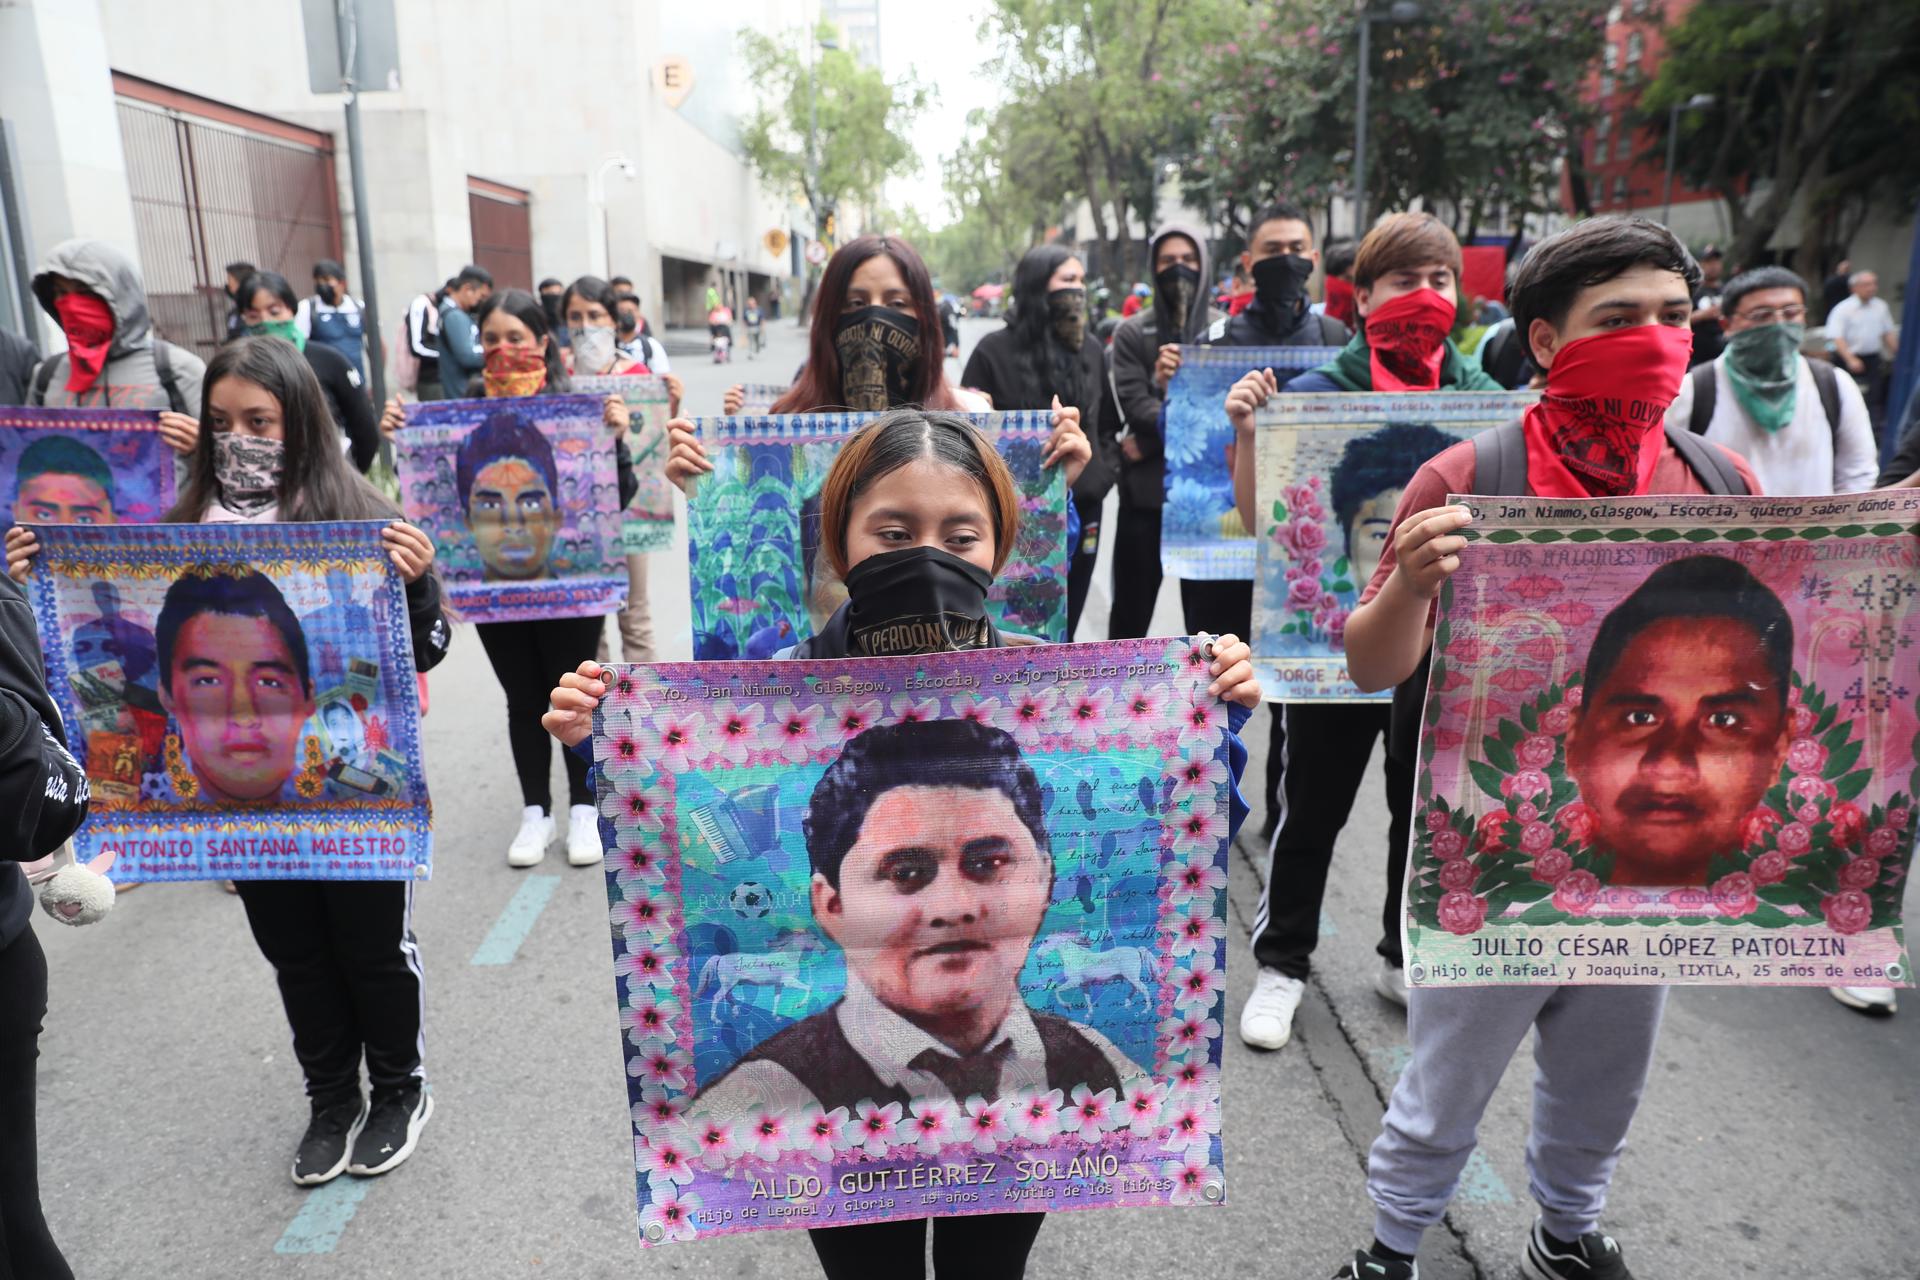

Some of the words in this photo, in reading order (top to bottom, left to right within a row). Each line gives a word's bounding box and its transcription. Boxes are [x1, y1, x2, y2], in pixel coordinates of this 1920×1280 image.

[665, 65, 680, 87] E
[1604, 399, 1622, 417] NI
[717, 420, 736, 431] Jan
[1472, 508, 1487, 521] o,
[1498, 506, 1526, 519] Jan
[1670, 504, 1739, 519] Escocia,
[1750, 505, 1803, 519] quiero
[1812, 503, 1850, 516] saber
[1857, 499, 1896, 513] dónde
[179, 529, 230, 541] Escocia,
[871, 618, 942, 655] PERDÓN
[659, 688, 688, 702] Yo,
[702, 685, 731, 699] Jan
[742, 683, 801, 698] Nimmo,
[814, 680, 892, 695] Glasgow,
[905, 673, 981, 691] Escocia,
[993, 669, 1041, 686] exijo
[1127, 663, 1165, 681] para
[1274, 668, 1325, 683] JORGE
[1319, 686, 1331, 695] de
[100, 840, 194, 858] ANTONIO
[207, 838, 299, 857] SANTANA
[311, 837, 406, 856] MAESTRO
[120, 863, 133, 872] de
[209, 861, 241, 871] Nieto
[248, 861, 261, 870] de
[1472, 938, 1543, 956] JULIO
[1558, 934, 1629, 956] CÉSAR
[1646, 934, 1716, 956] LÓPEZ
[1732, 938, 1846, 956] PATOLZIN
[1432, 964, 1467, 980] Hijo
[1476, 964, 1493, 977] de
[1503, 963, 1557, 976] Rafael
[1568, 967, 1576, 979] y
[1586, 964, 1666, 979] Joaquina,
[1679, 964, 1741, 979] TIXTLA,
[1753, 964, 1771, 977] 25
[1780, 963, 1815, 977] años
[1825, 963, 1844, 977] de
[1854, 963, 1884, 977] eda
[752, 1175, 822, 1200] ALDO
[839, 1162, 998, 1195] GUTIÉRREZ
[1016, 1154, 1120, 1181] SOLANO
[697, 1209, 734, 1225] Hijo
[742, 1206, 758, 1219] de
[768, 1202, 818, 1217] Leonel
[826, 1205, 836, 1217] y
[844, 1196, 895, 1212] Gloria
[920, 1192, 937, 1205] 19
[945, 1189, 979, 1203] años
[1004, 1184, 1055, 1202] Ayutla
[1063, 1185, 1080, 1198] de
[1089, 1182, 1113, 1196] los
